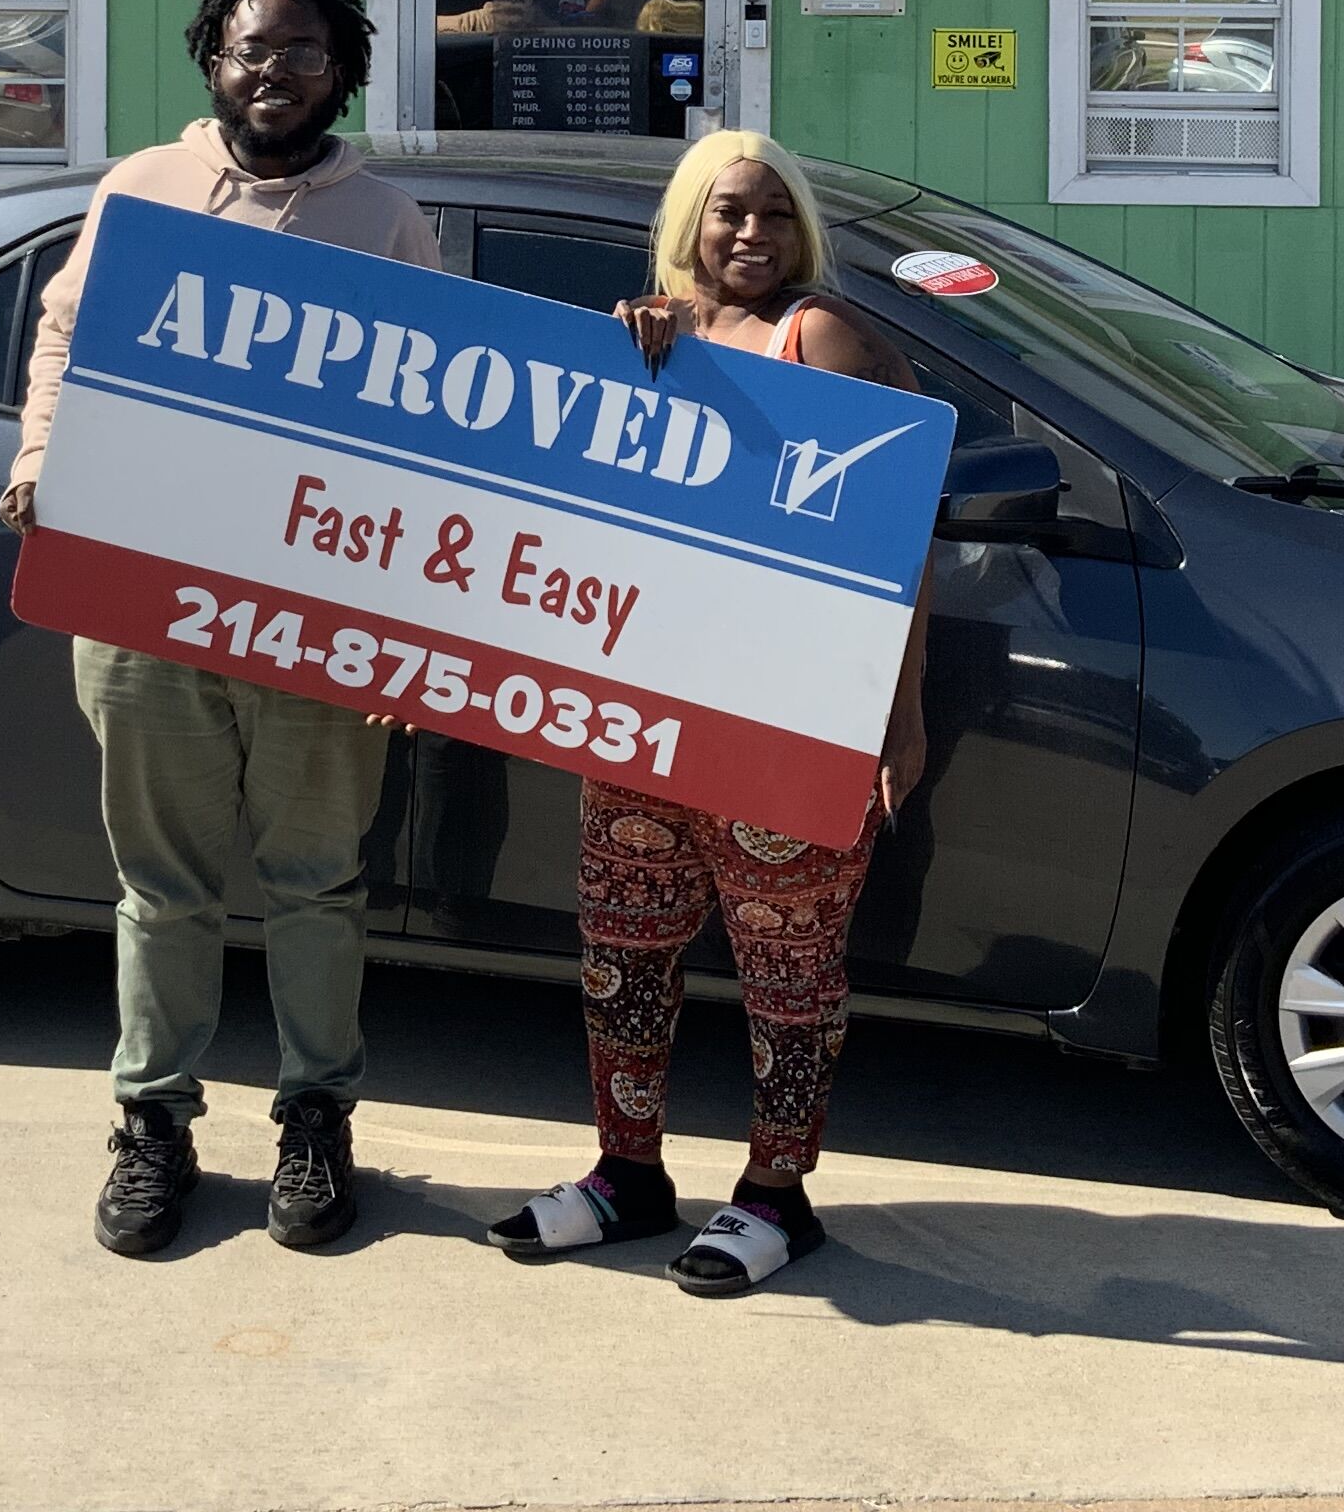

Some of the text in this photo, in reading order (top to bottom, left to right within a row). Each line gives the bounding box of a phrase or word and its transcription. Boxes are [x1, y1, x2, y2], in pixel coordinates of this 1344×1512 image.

[512, 37, 631, 49] OPENING HOURS
[947, 34, 1003, 48] SMILE!
[512, 63, 538, 73] MON.
[566, 63, 588, 73] 9.00
[512, 76, 540, 86] TUES.
[566, 76, 588, 86] 9.00
[937, 74, 1012, 84] YOU'RE ON CAMERA
[512, 90, 536, 100] WED.
[566, 90, 588, 100] 9.00
[512, 103, 542, 113] THUR.
[566, 103, 588, 113] 9.00
[566, 116, 588, 126] 9.00
[136, 270, 732, 487] APPROVED
[283, 474, 641, 657] Fast & Easy
[166, 585, 683, 778] 214-875-0331
[712, 1214, 750, 1232] NIKE
